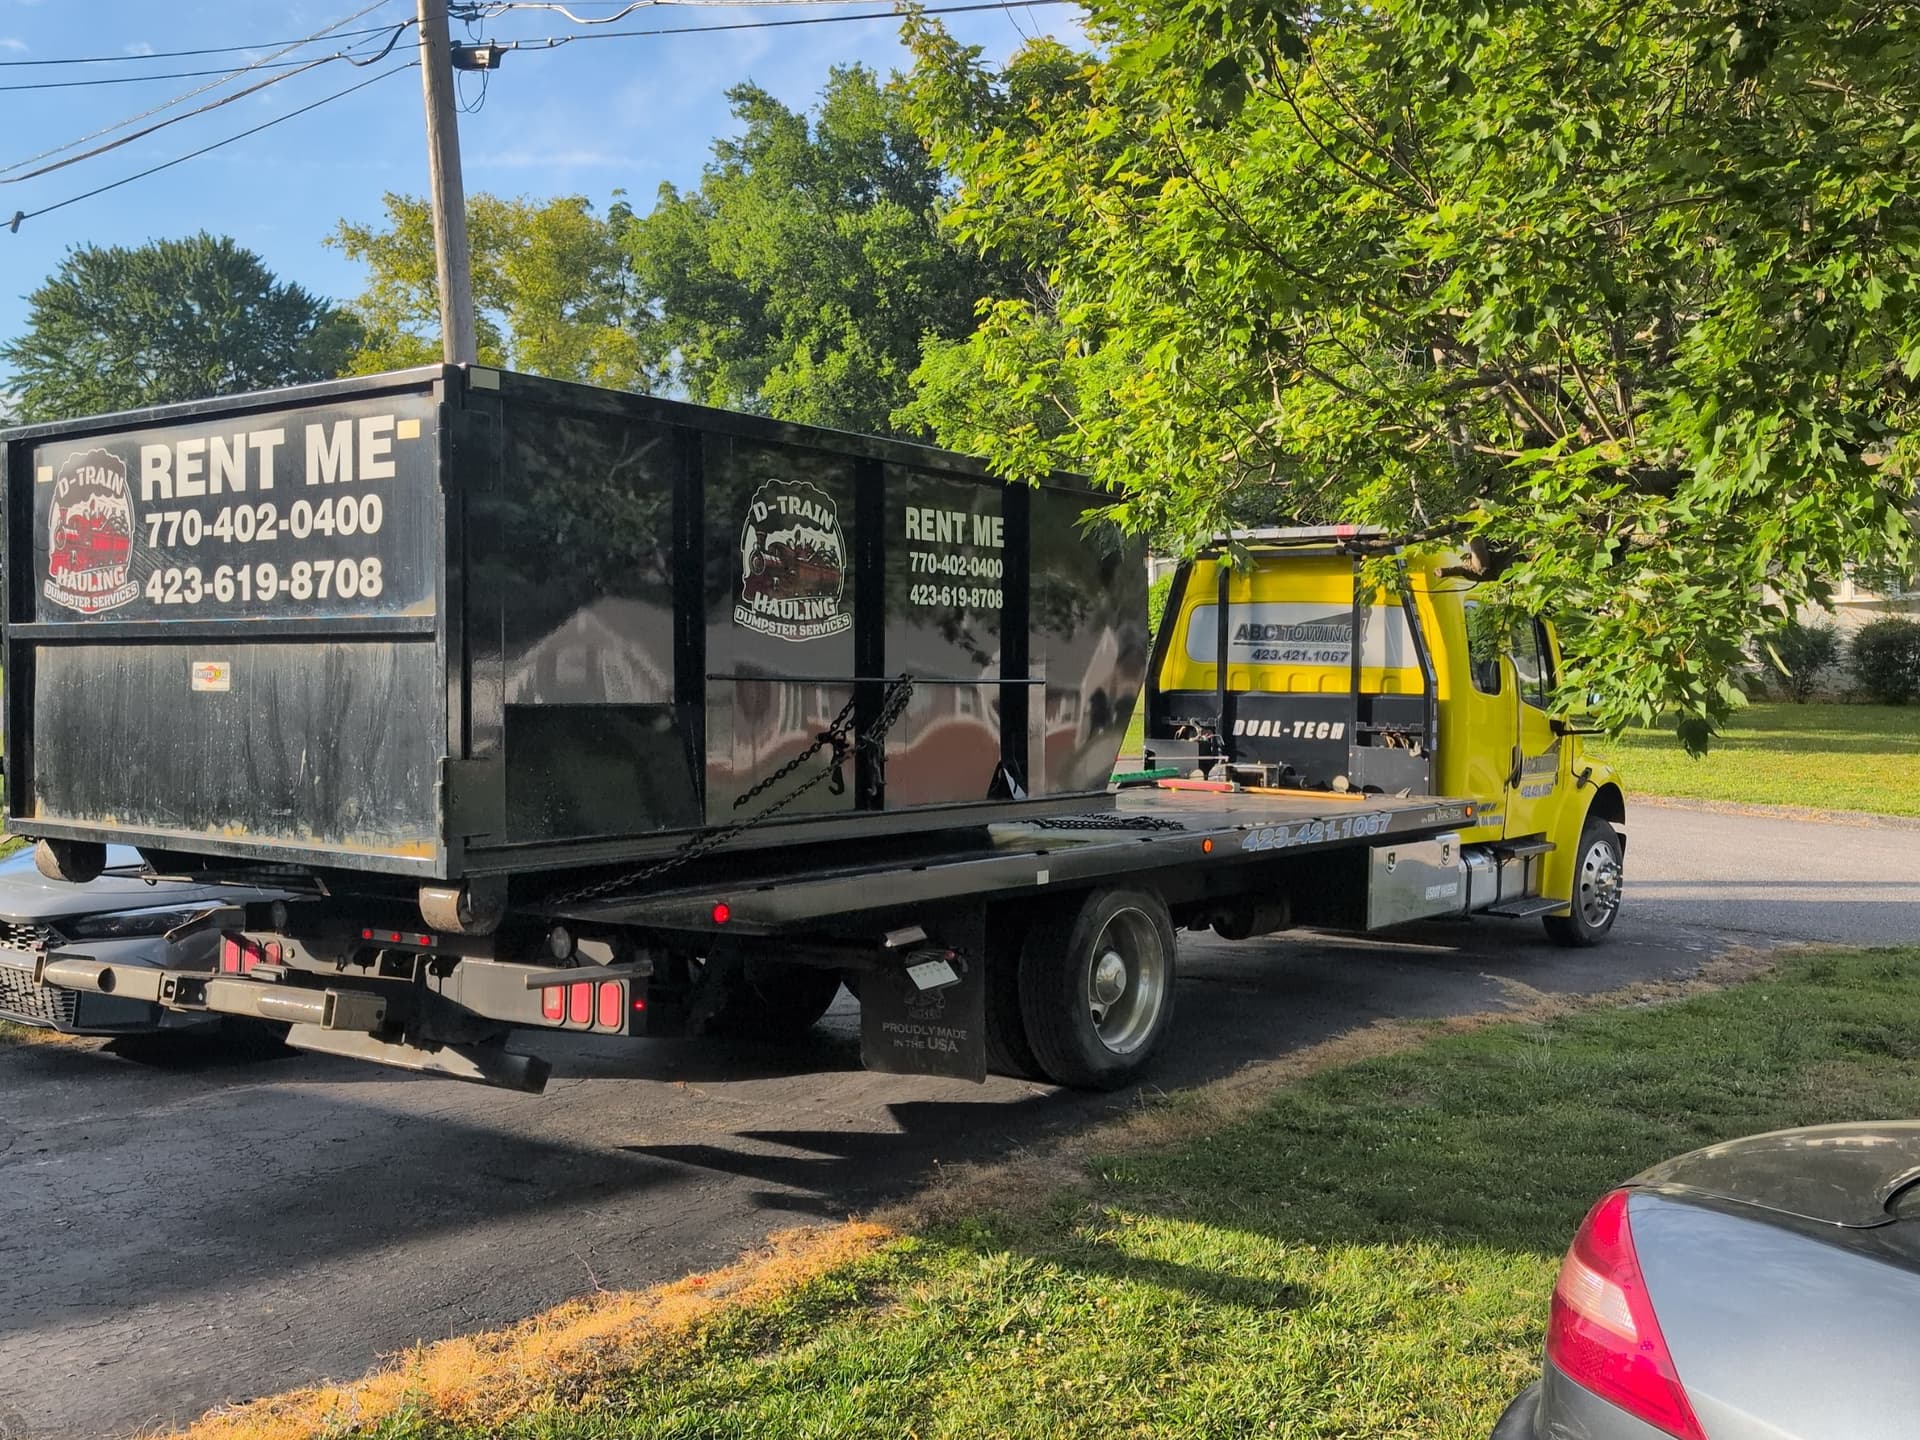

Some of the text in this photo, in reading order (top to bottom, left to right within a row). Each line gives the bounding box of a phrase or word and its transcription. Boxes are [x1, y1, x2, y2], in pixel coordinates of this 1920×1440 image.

[140, 414, 396, 501] RENT ME
[58, 466, 124, 498] D-TRAIN
[145, 494, 383, 549] 770-402-0400
[753, 496, 834, 531] D-TRAIN
[905, 506, 1005, 548] RENT ME
[56, 566, 126, 592] HAULING
[909, 552, 1004, 579] 770-402-0400
[145, 557, 383, 604] 423-619-8708
[46, 582, 138, 608] DUMPSTER SERVICES
[754, 591, 836, 620] HAULING
[910, 584, 1004, 609] 423-619-8708
[735, 608, 850, 637] DUMPSTER SERVICES
[1233, 624, 1277, 641] ABC
[1251, 648, 1350, 662] 423.421.1067
[1232, 720, 1345, 740] DUAL-TECH
[1241, 813, 1393, 852] 423.421.1067
[882, 1022, 968, 1041] PROUDLY MADE
[893, 1037, 959, 1053] IN THE USA
